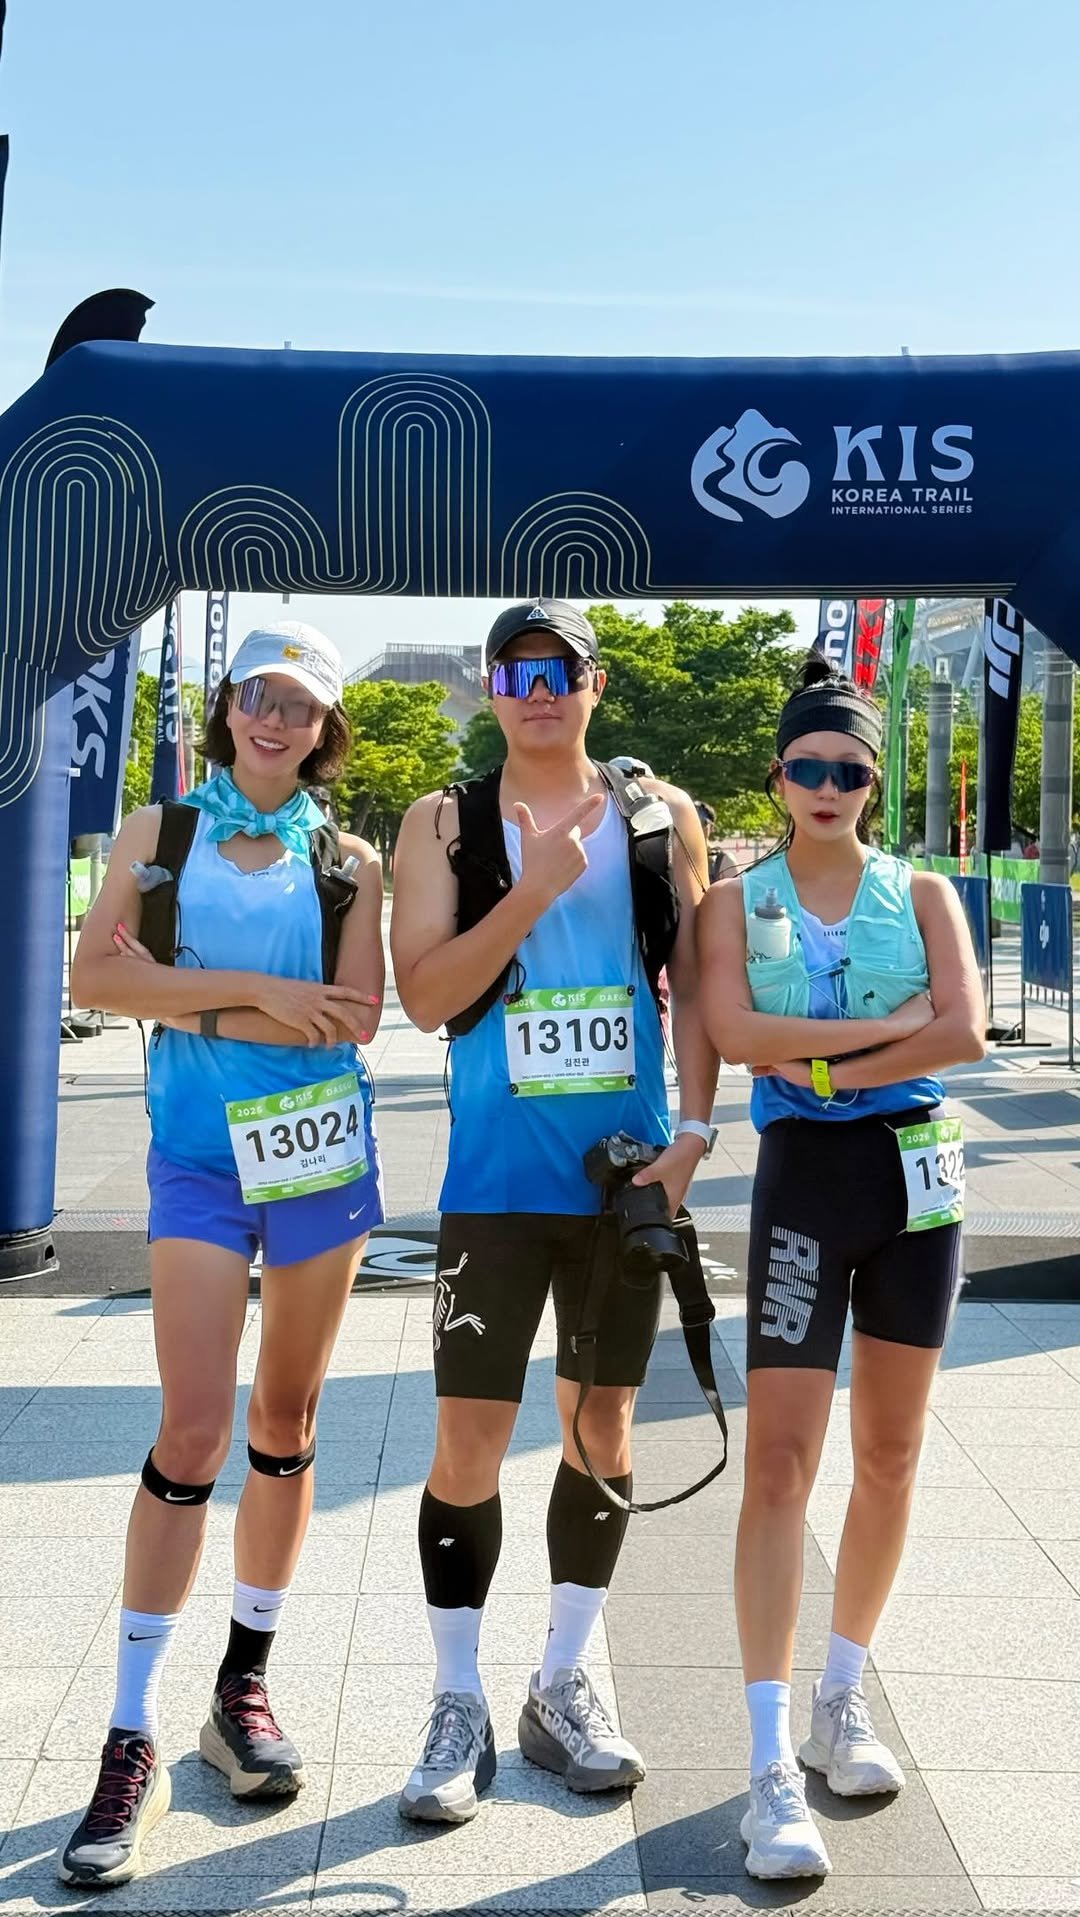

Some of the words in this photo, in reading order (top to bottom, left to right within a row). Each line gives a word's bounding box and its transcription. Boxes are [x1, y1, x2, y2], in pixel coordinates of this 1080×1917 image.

[832, 425, 974, 482] KIS
[832, 488, 902, 502] KOREA
[912, 487, 973, 502] TRAIL
[832, 506, 927, 514] INTERNATIONAL
[931, 505, 973, 514] SERIES
[517, 1016, 628, 1056] 13103
[236, 1106, 263, 1117] 2026
[246, 1104, 358, 1163] 13024
